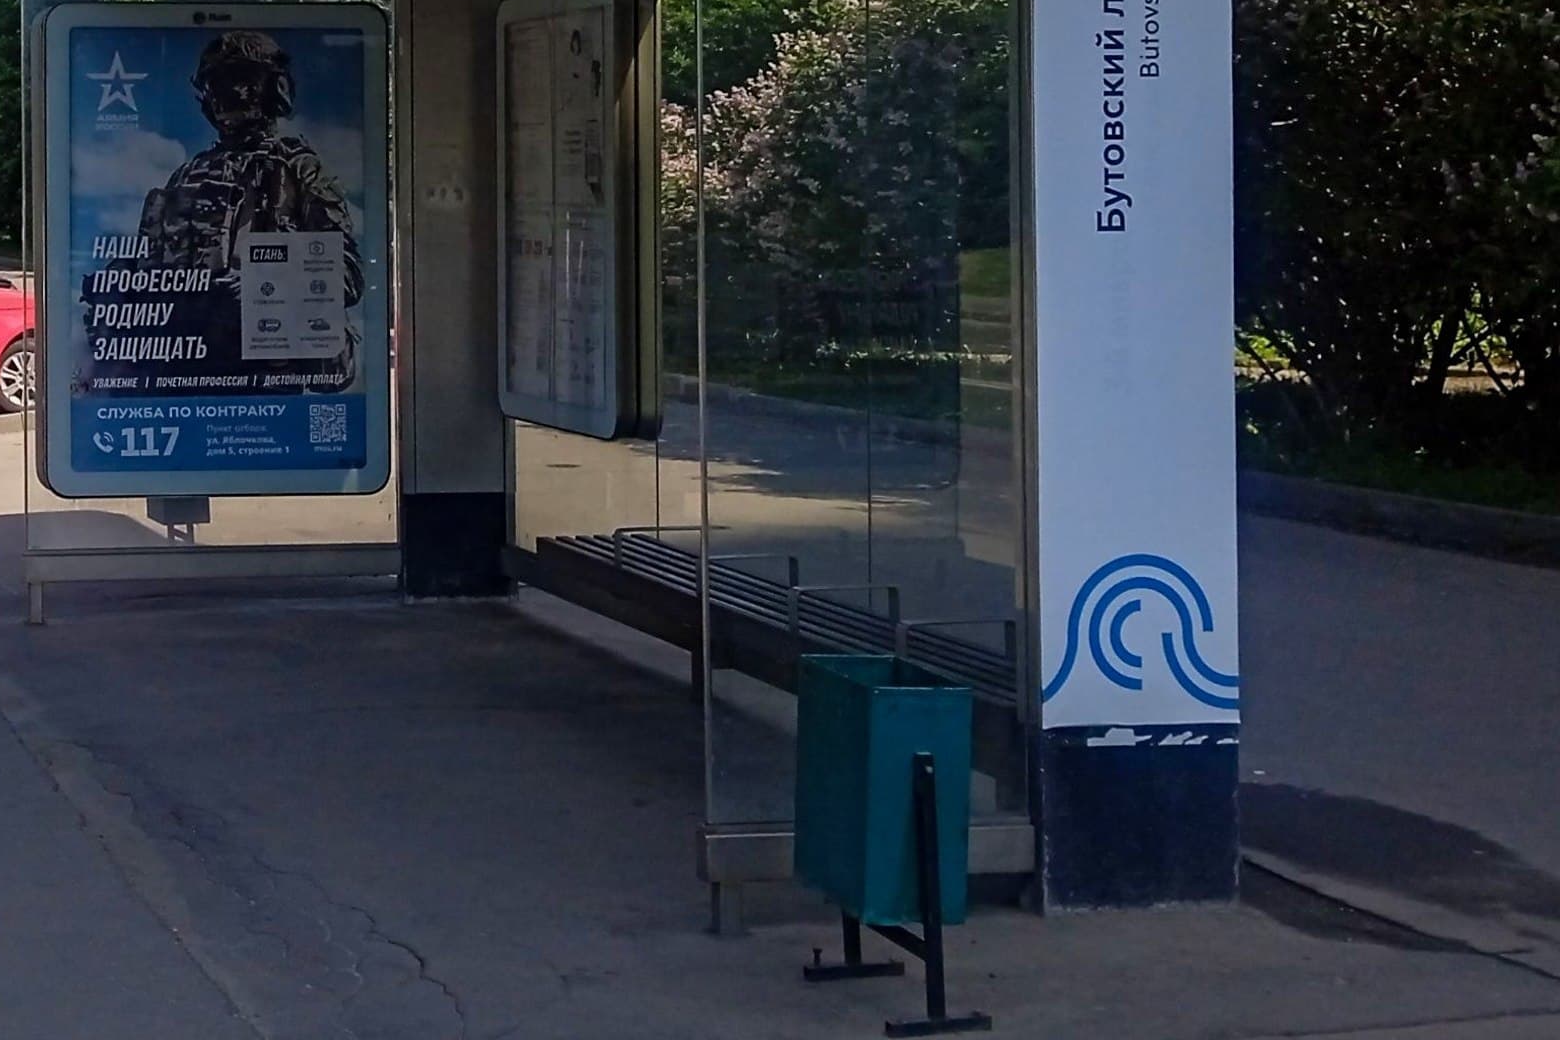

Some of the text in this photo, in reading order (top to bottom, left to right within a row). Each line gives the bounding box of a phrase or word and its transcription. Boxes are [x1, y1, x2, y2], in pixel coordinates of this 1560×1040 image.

[1096, 29, 1133, 233] Бутовский
[92, 236, 149, 259] НАША
[92, 268, 212, 293] ПРОФЕССИЯ
[92, 302, 174, 330] РОДИНУ
[93, 336, 208, 363] ЗАЩИЩАТЬ
[93, 377, 138, 389] УВАЖЕНИЕ
[156, 376, 198, 388] ПОЧЕТНАЯ
[199, 375, 248, 387] ПРОФЕССИЯ
[263, 374, 311, 387] ДОСТОЙНАЯ
[97, 404, 287, 420] СЛУЖБА ПО КОНТРАКТУ
[121, 426, 180, 457] 117
